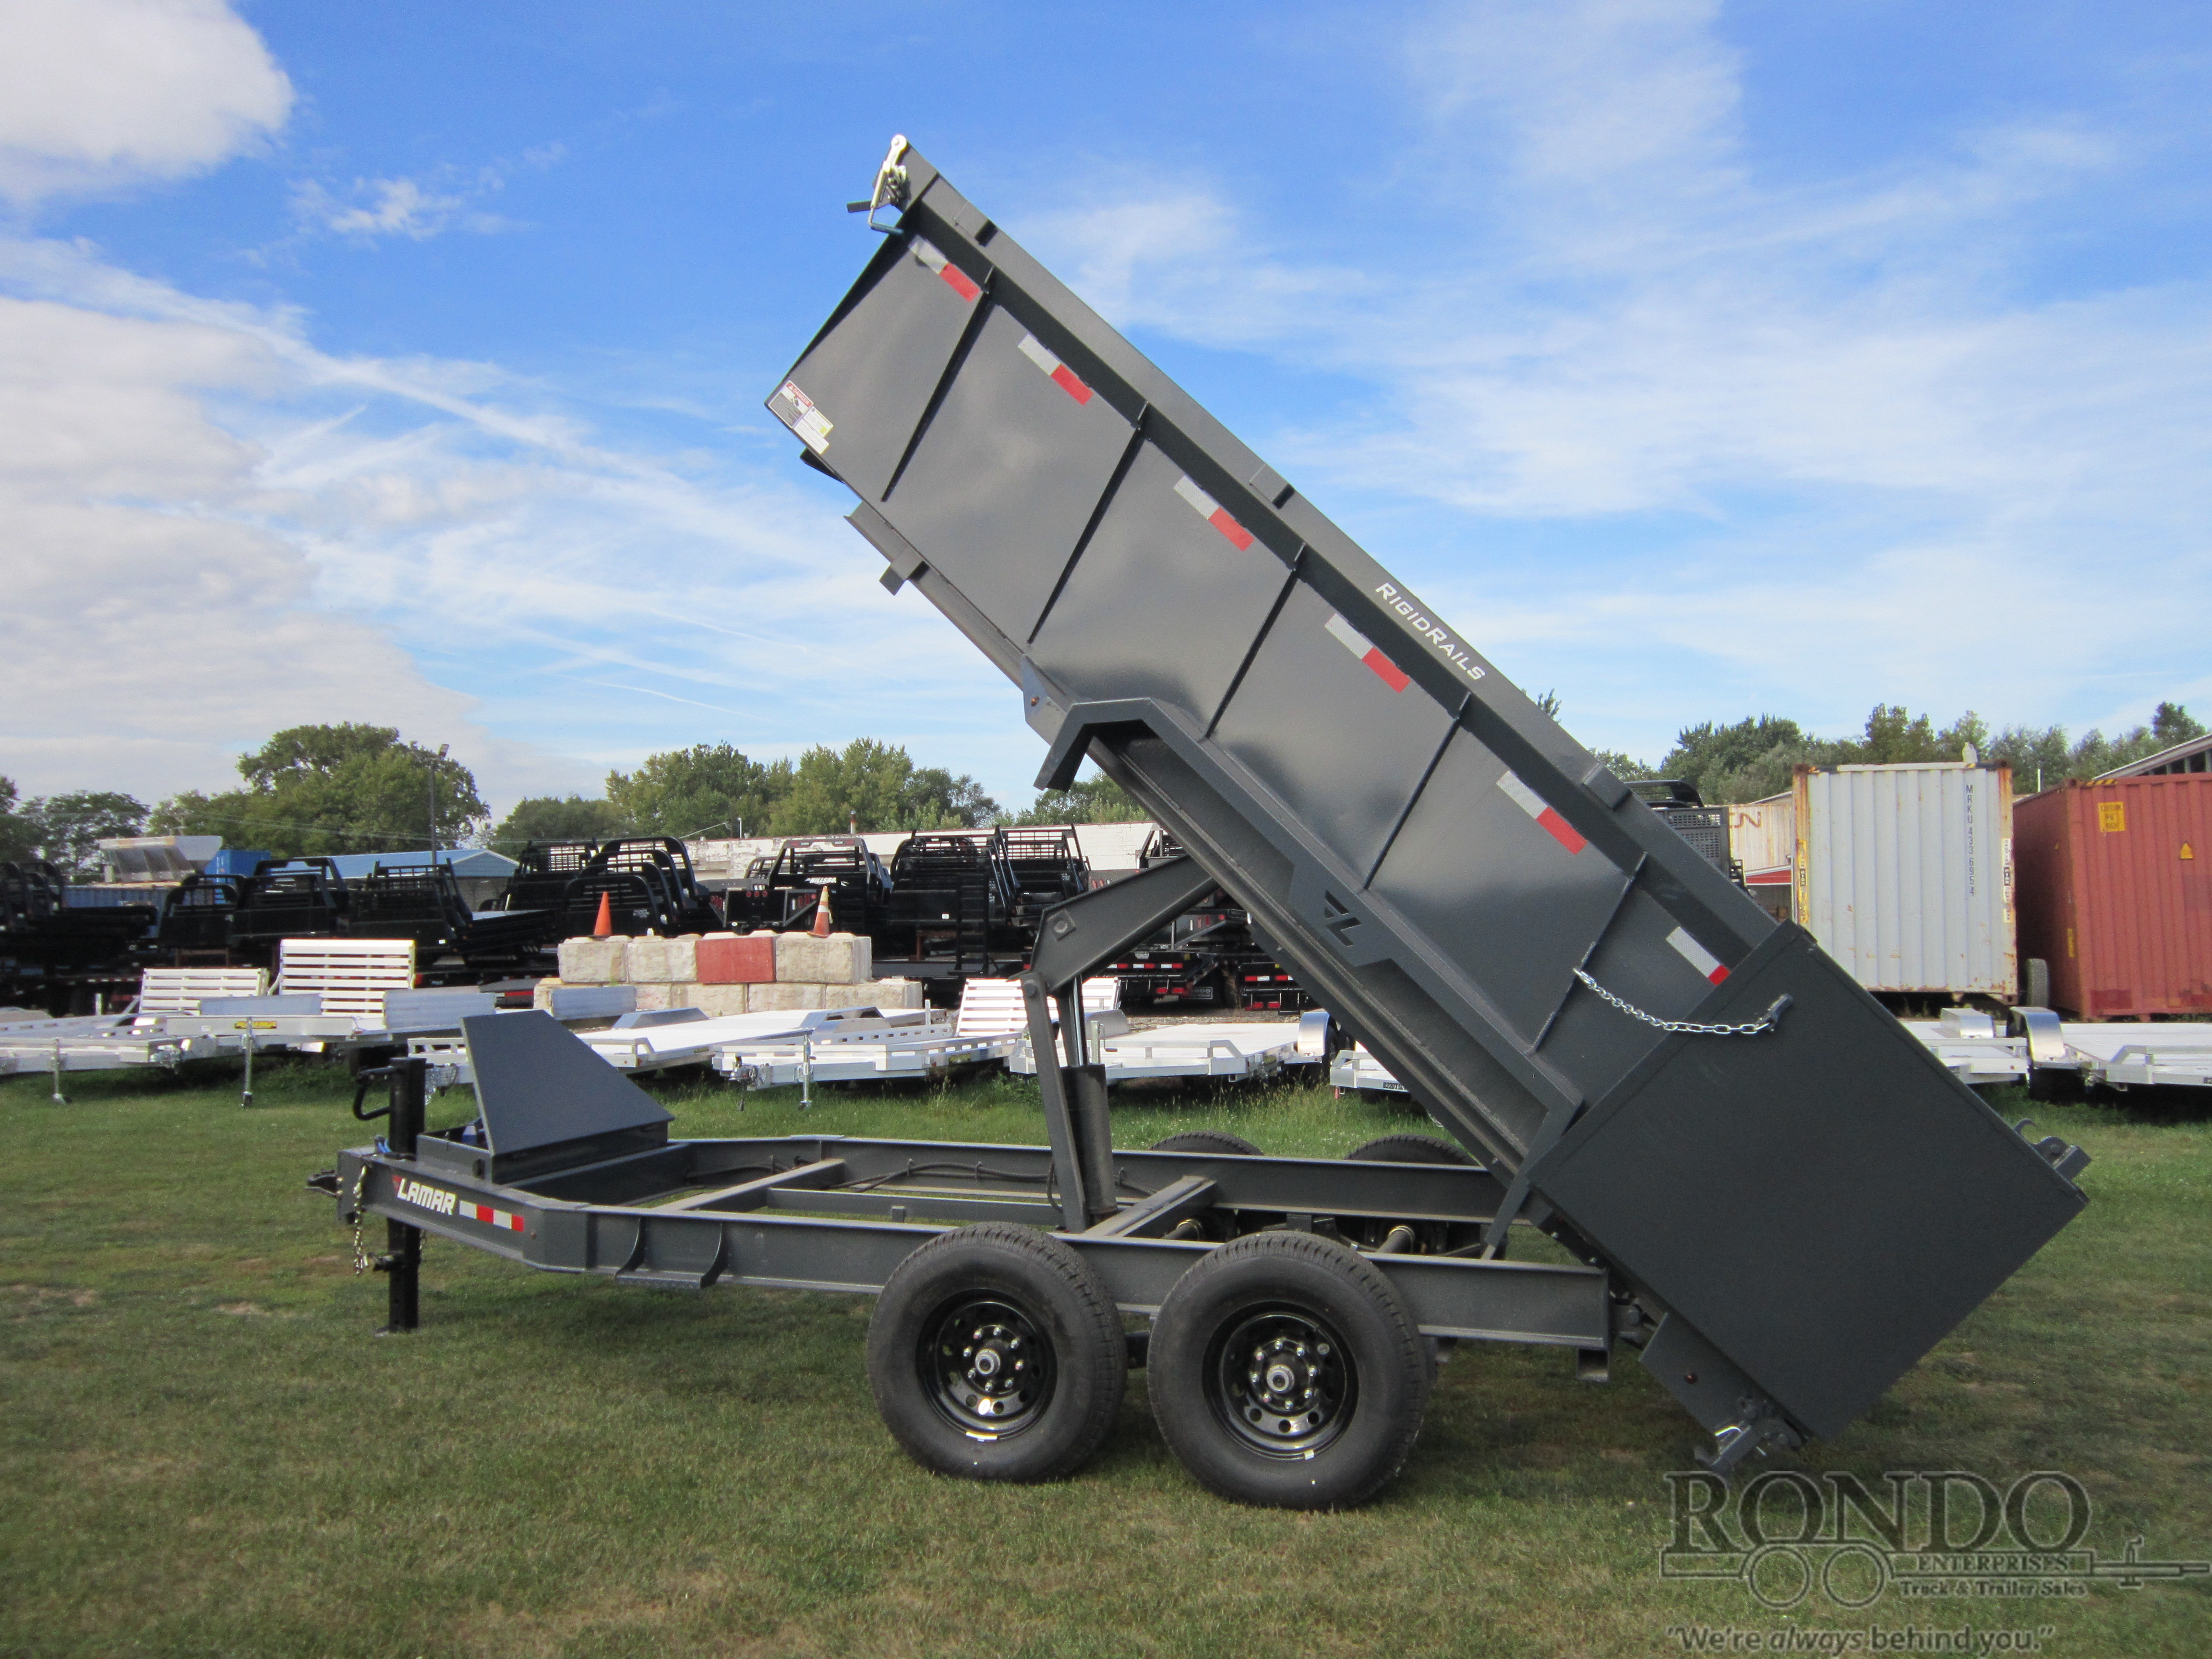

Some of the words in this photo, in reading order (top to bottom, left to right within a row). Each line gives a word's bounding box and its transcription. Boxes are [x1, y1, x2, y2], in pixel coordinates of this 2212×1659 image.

[793, 388, 810, 405] DANGER
[1375, 583, 1486, 680] RIGIDRAILS
[397, 1178, 457, 1216] LAMAR
